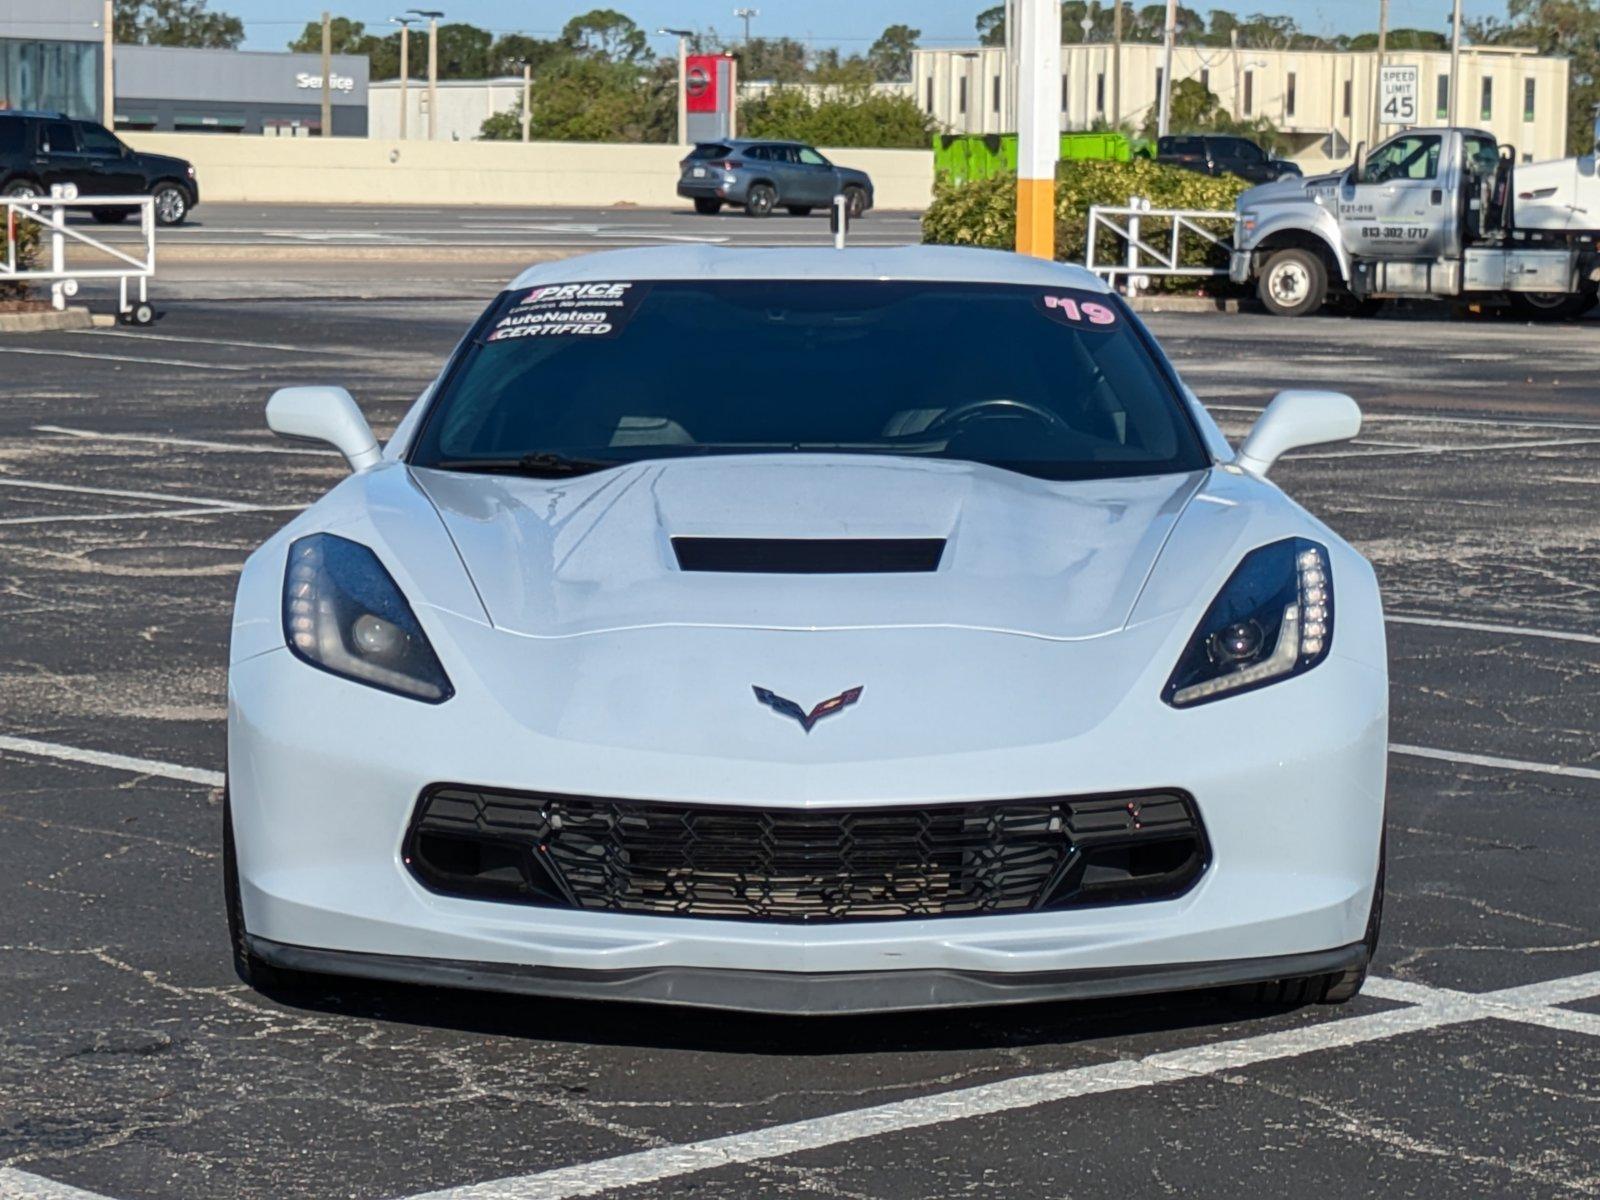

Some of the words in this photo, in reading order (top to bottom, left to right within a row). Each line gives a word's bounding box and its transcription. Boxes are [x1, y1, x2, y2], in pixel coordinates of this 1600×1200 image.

[1383, 72, 1415, 81] SPEED
[1386, 85, 1411, 94] LIMIT
[1384, 96, 1413, 118] 45
[1044, 295, 1115, 325] '19
[496, 312, 607, 328] AutoNation
[496, 323, 612, 340] CERTIFIED
